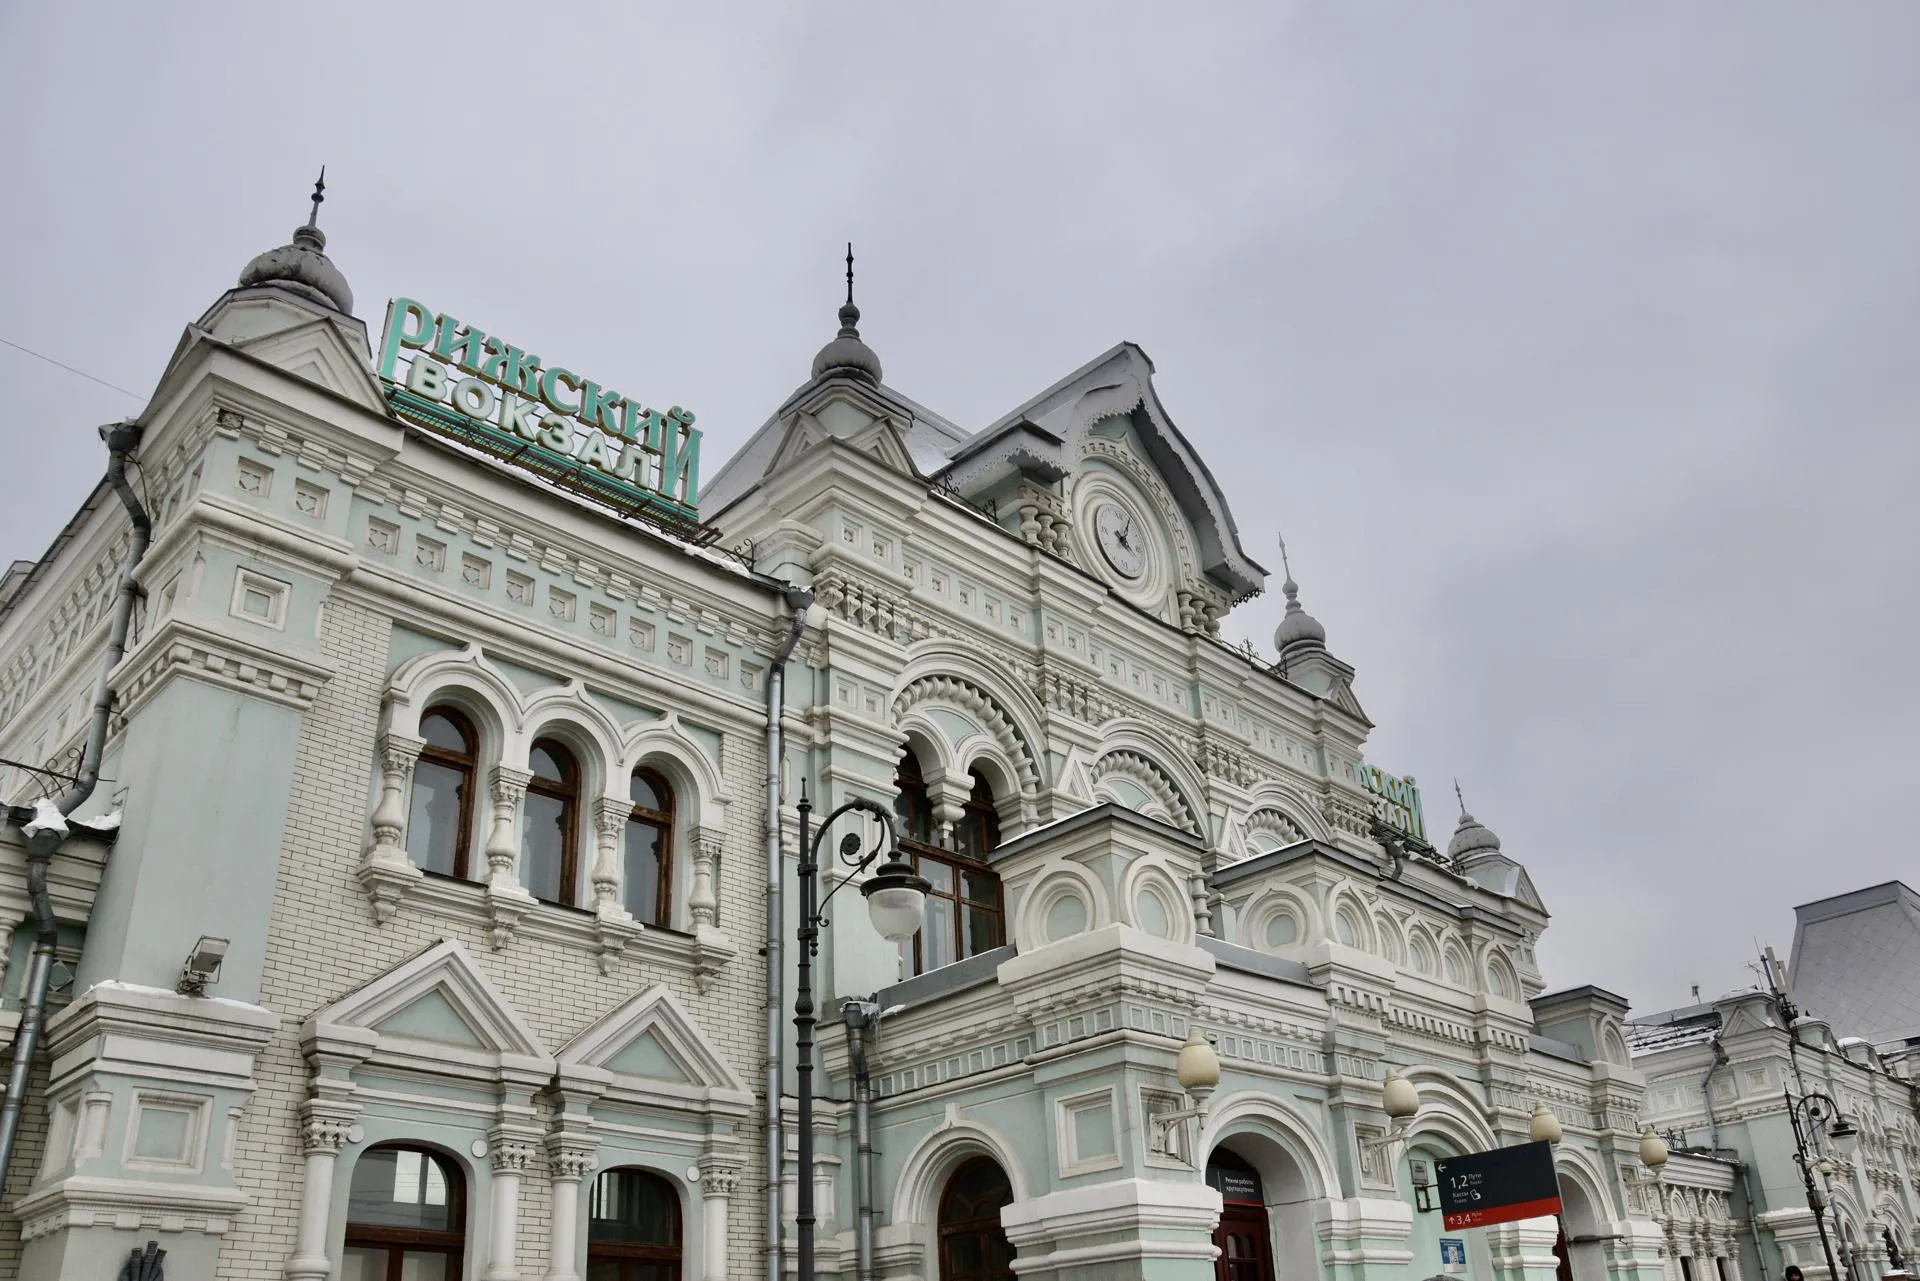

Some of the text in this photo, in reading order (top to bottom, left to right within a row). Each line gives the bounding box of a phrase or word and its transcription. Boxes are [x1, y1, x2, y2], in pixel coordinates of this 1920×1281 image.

[377, 297, 703, 509] РИЖСКИЙ
[405, 354, 652, 490] ВОКЗАЛ
[1450, 1175, 1469, 1189] 1,2
[1456, 1213, 1471, 1225] 3,4
